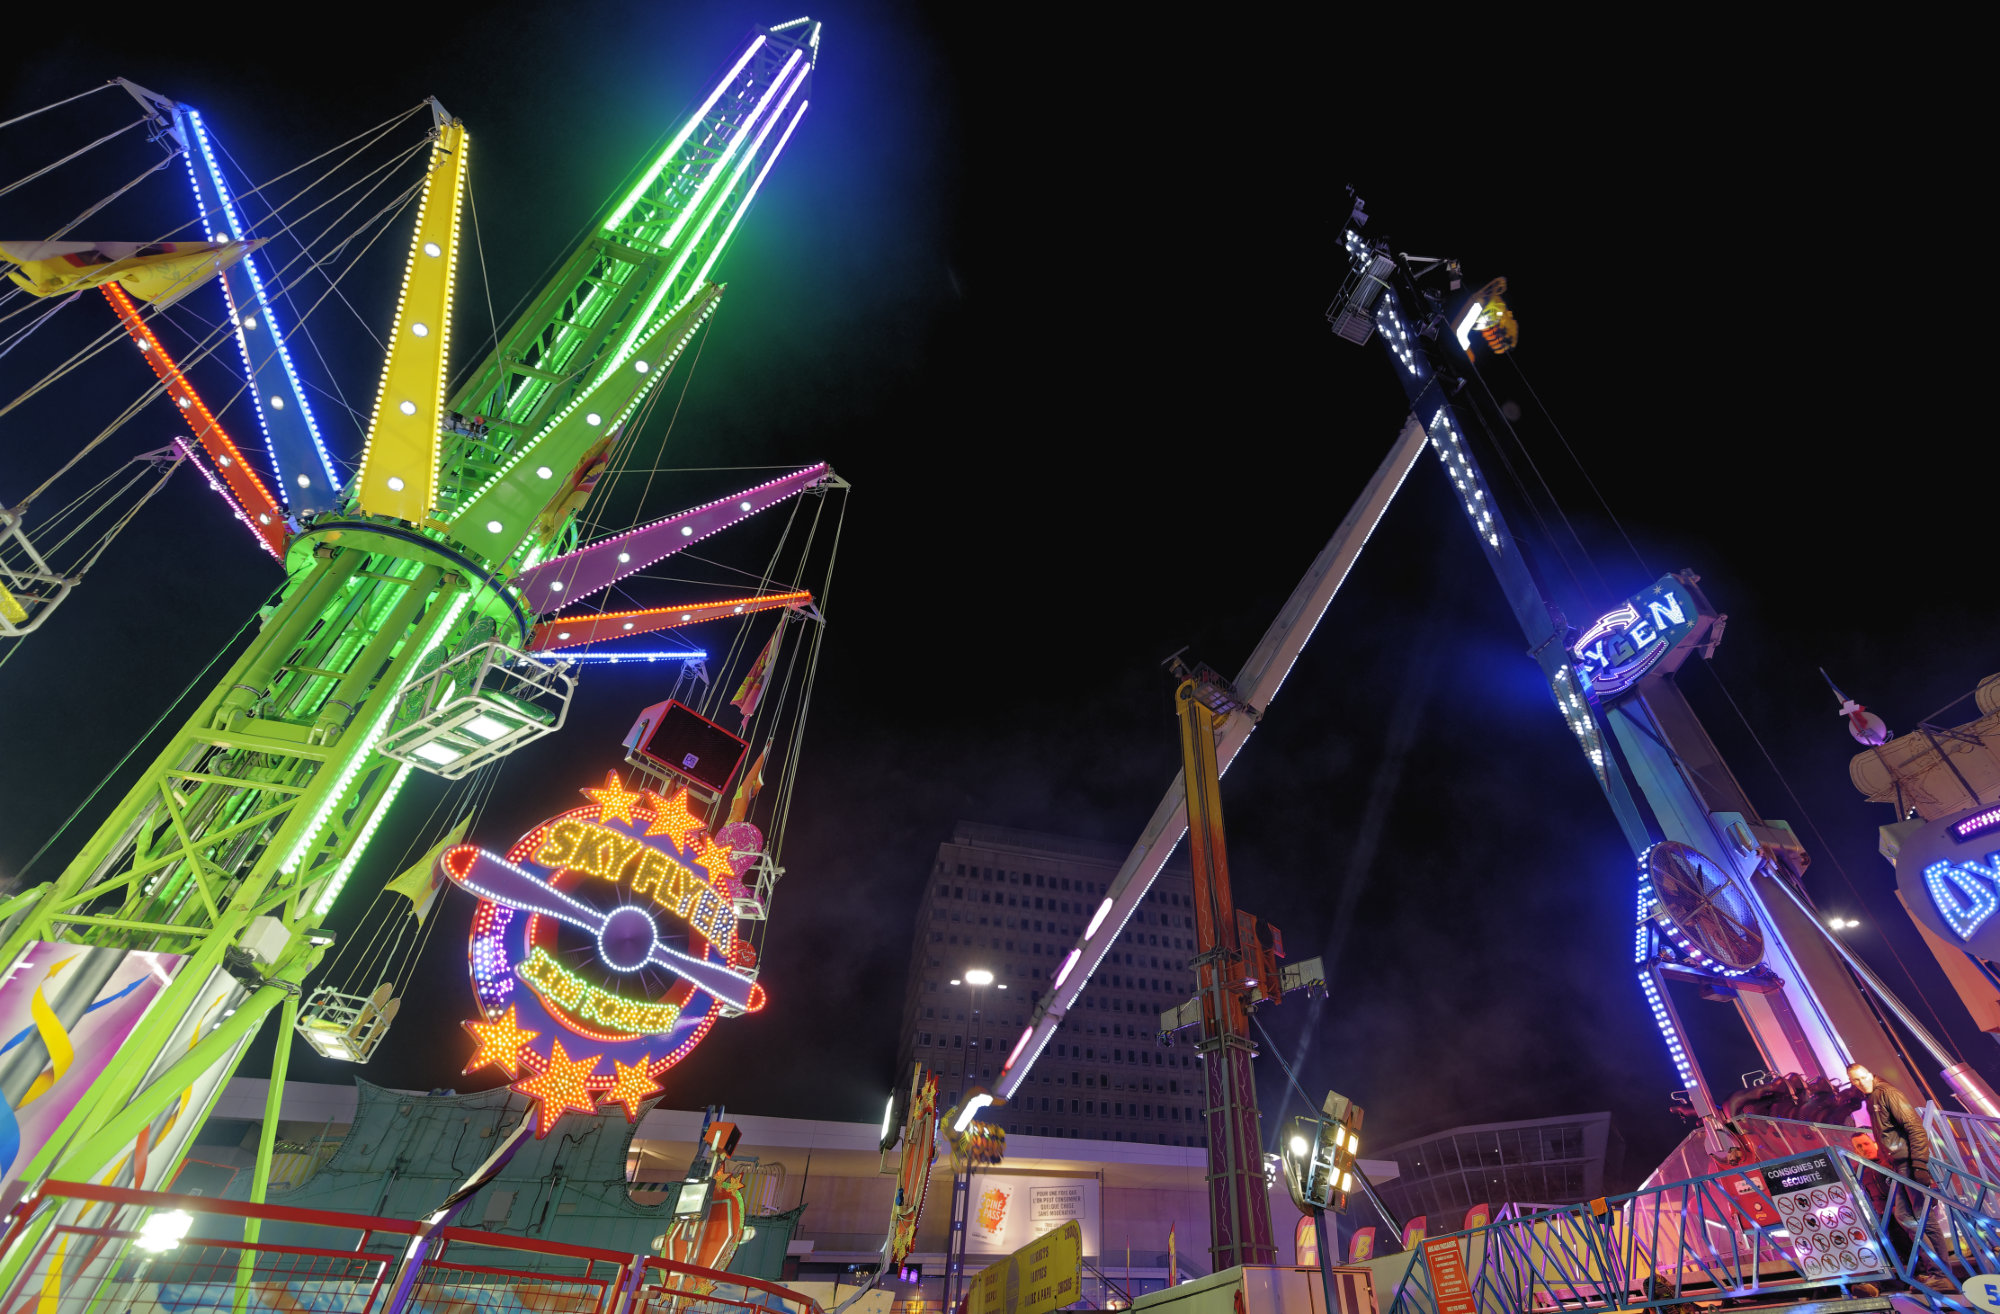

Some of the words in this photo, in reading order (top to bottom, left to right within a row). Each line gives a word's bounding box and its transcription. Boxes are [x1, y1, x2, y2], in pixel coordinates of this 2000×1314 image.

[1583, 592, 1686, 671] YGEN
[537, 818, 643, 881] SKY
[631, 848, 738, 957] FLYER
[581, 986, 680, 1032] TOWER
[1767, 1162, 1814, 1180] CONSIGNES
[1815, 1159, 1827, 1168] DE
[1781, 1171, 1822, 1188] SÉCURITÉ
[983, 1209, 1001, 1220] PASS
[985, 1199, 1004, 1210] CINÉ
